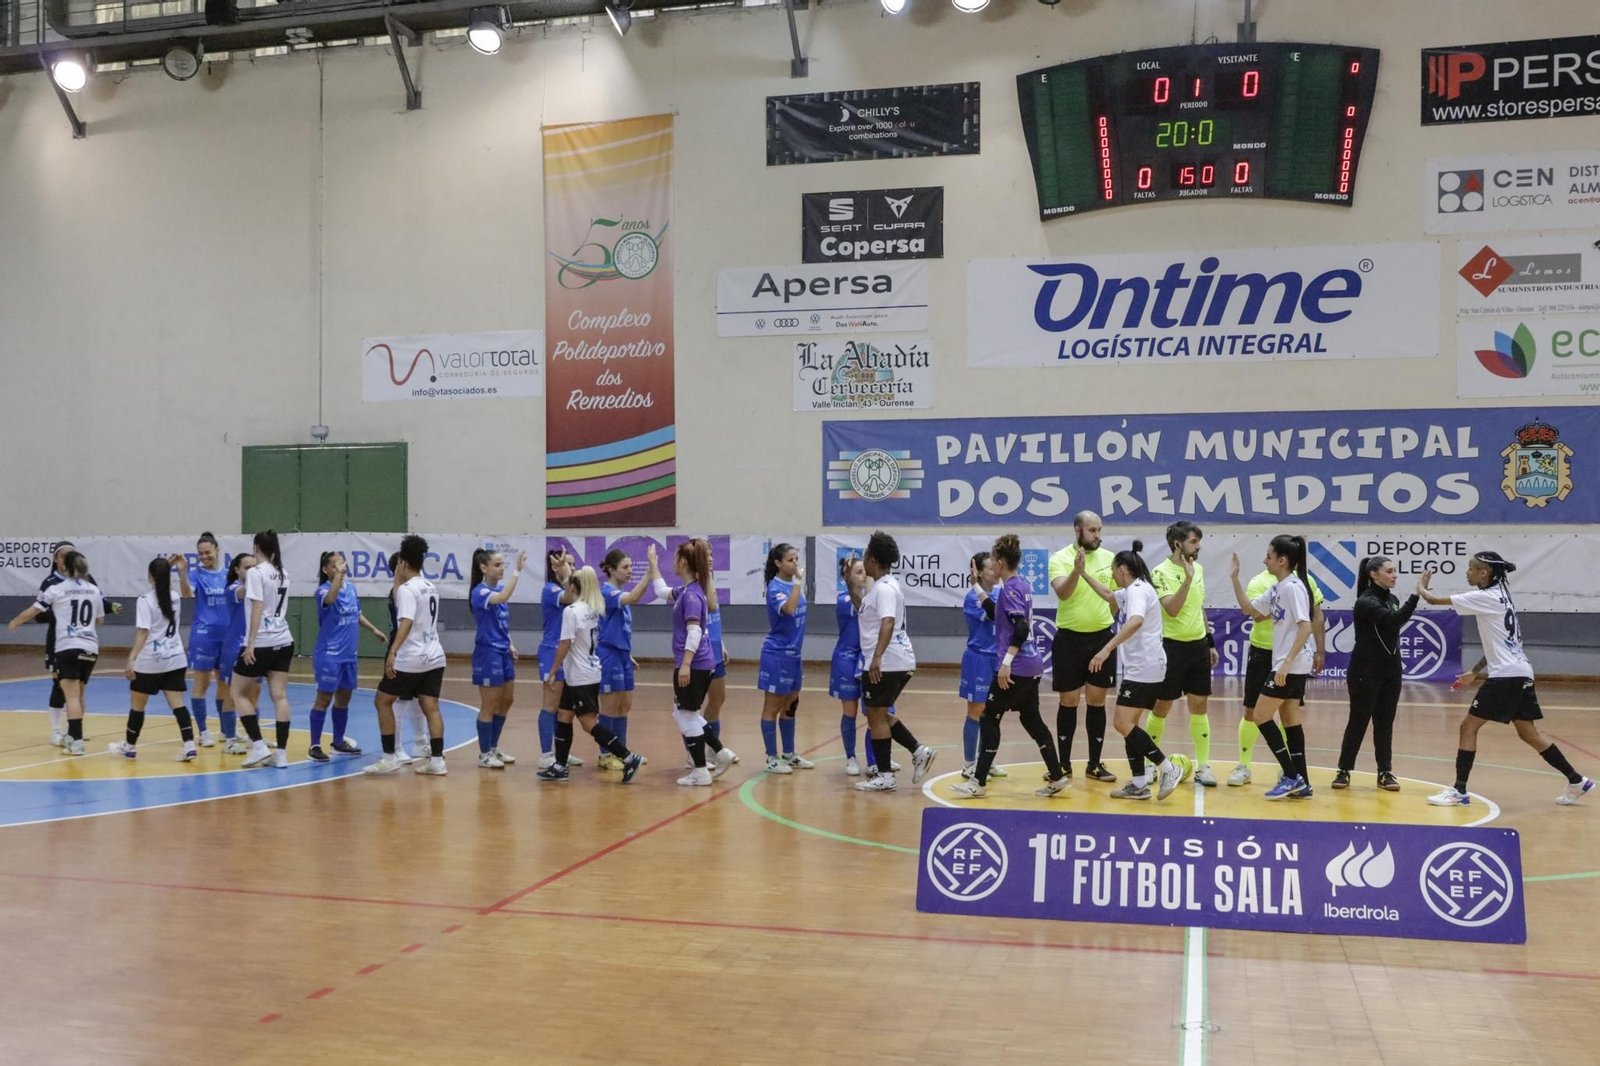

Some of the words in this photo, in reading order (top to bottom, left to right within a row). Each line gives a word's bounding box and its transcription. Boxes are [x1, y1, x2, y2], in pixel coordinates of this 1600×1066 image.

[1137, 61, 1161, 70] LOCAL
[1218, 54, 1258, 64] VISITANTE
[1041, 74, 1047, 83] E
[1242, 71, 1259, 98] 0
[1154, 77, 1169, 103] 0
[1194, 79, 1201, 97] 1
[857, 106, 900, 118] CHILLY'S
[1180, 101, 1208, 109] PERIODO
[829, 124, 856, 133] Explore
[875, 121, 893, 130] 1000
[848, 131, 898, 141] combinations
[1233, 142, 1267, 150] MONDO
[1138, 167, 1152, 189] 0
[1234, 162, 1249, 184] 0
[1493, 167, 1554, 188] CEN
[1569, 165, 1600, 178] DIST
[1134, 190, 1156, 199] FALTAS
[1179, 188, 1208, 197] JUGADOR
[1230, 185, 1253, 194] FALTAS
[1314, 193, 1349, 201] MONDO
[1043, 205, 1075, 215] MONDO
[621, 217, 651, 231] anos
[820, 224, 863, 233] SEAT
[873, 222, 925, 230] CUPRA
[820, 236, 925, 260] Copersa
[1519, 262, 1571, 276] Lemos
[751, 272, 892, 304] Apersa
[1026, 256, 1363, 332] Ontime
[568, 308, 652, 335] Complexo
[552, 338, 666, 368] Polideportivo
[1057, 333, 1191, 360] LOGÍSTICA
[1197, 332, 1328, 356] INTEGRAL
[439, 349, 539, 369] valortotal
[596, 368, 623, 386] dos
[411, 386, 498, 399] info@vtasociados.es
[566, 388, 654, 411] Remedios
[811, 401, 831, 409] Valle
[861, 399, 872, 407] 43
[879, 399, 915, 407] Ourense
[935, 418, 1162, 465] PAVILLÓN
[1184, 424, 1480, 462] MUNICIPAL
[937, 475, 1070, 518] DOS
[1099, 471, 1480, 517] REMEDIOS
[1367, 541, 1467, 556] DEPORTE
[1398, 560, 1456, 575] LEGO
[274, 587, 288, 617] 7
[70, 599, 93, 627] 10
[429, 596, 437, 627] 9
[1075, 835, 1299, 861] DIVISIÓN
[1073, 853, 1202, 911] FÚTBOL
[1214, 865, 1303, 916] SALA
[1324, 902, 1400, 921] Iberdrola
